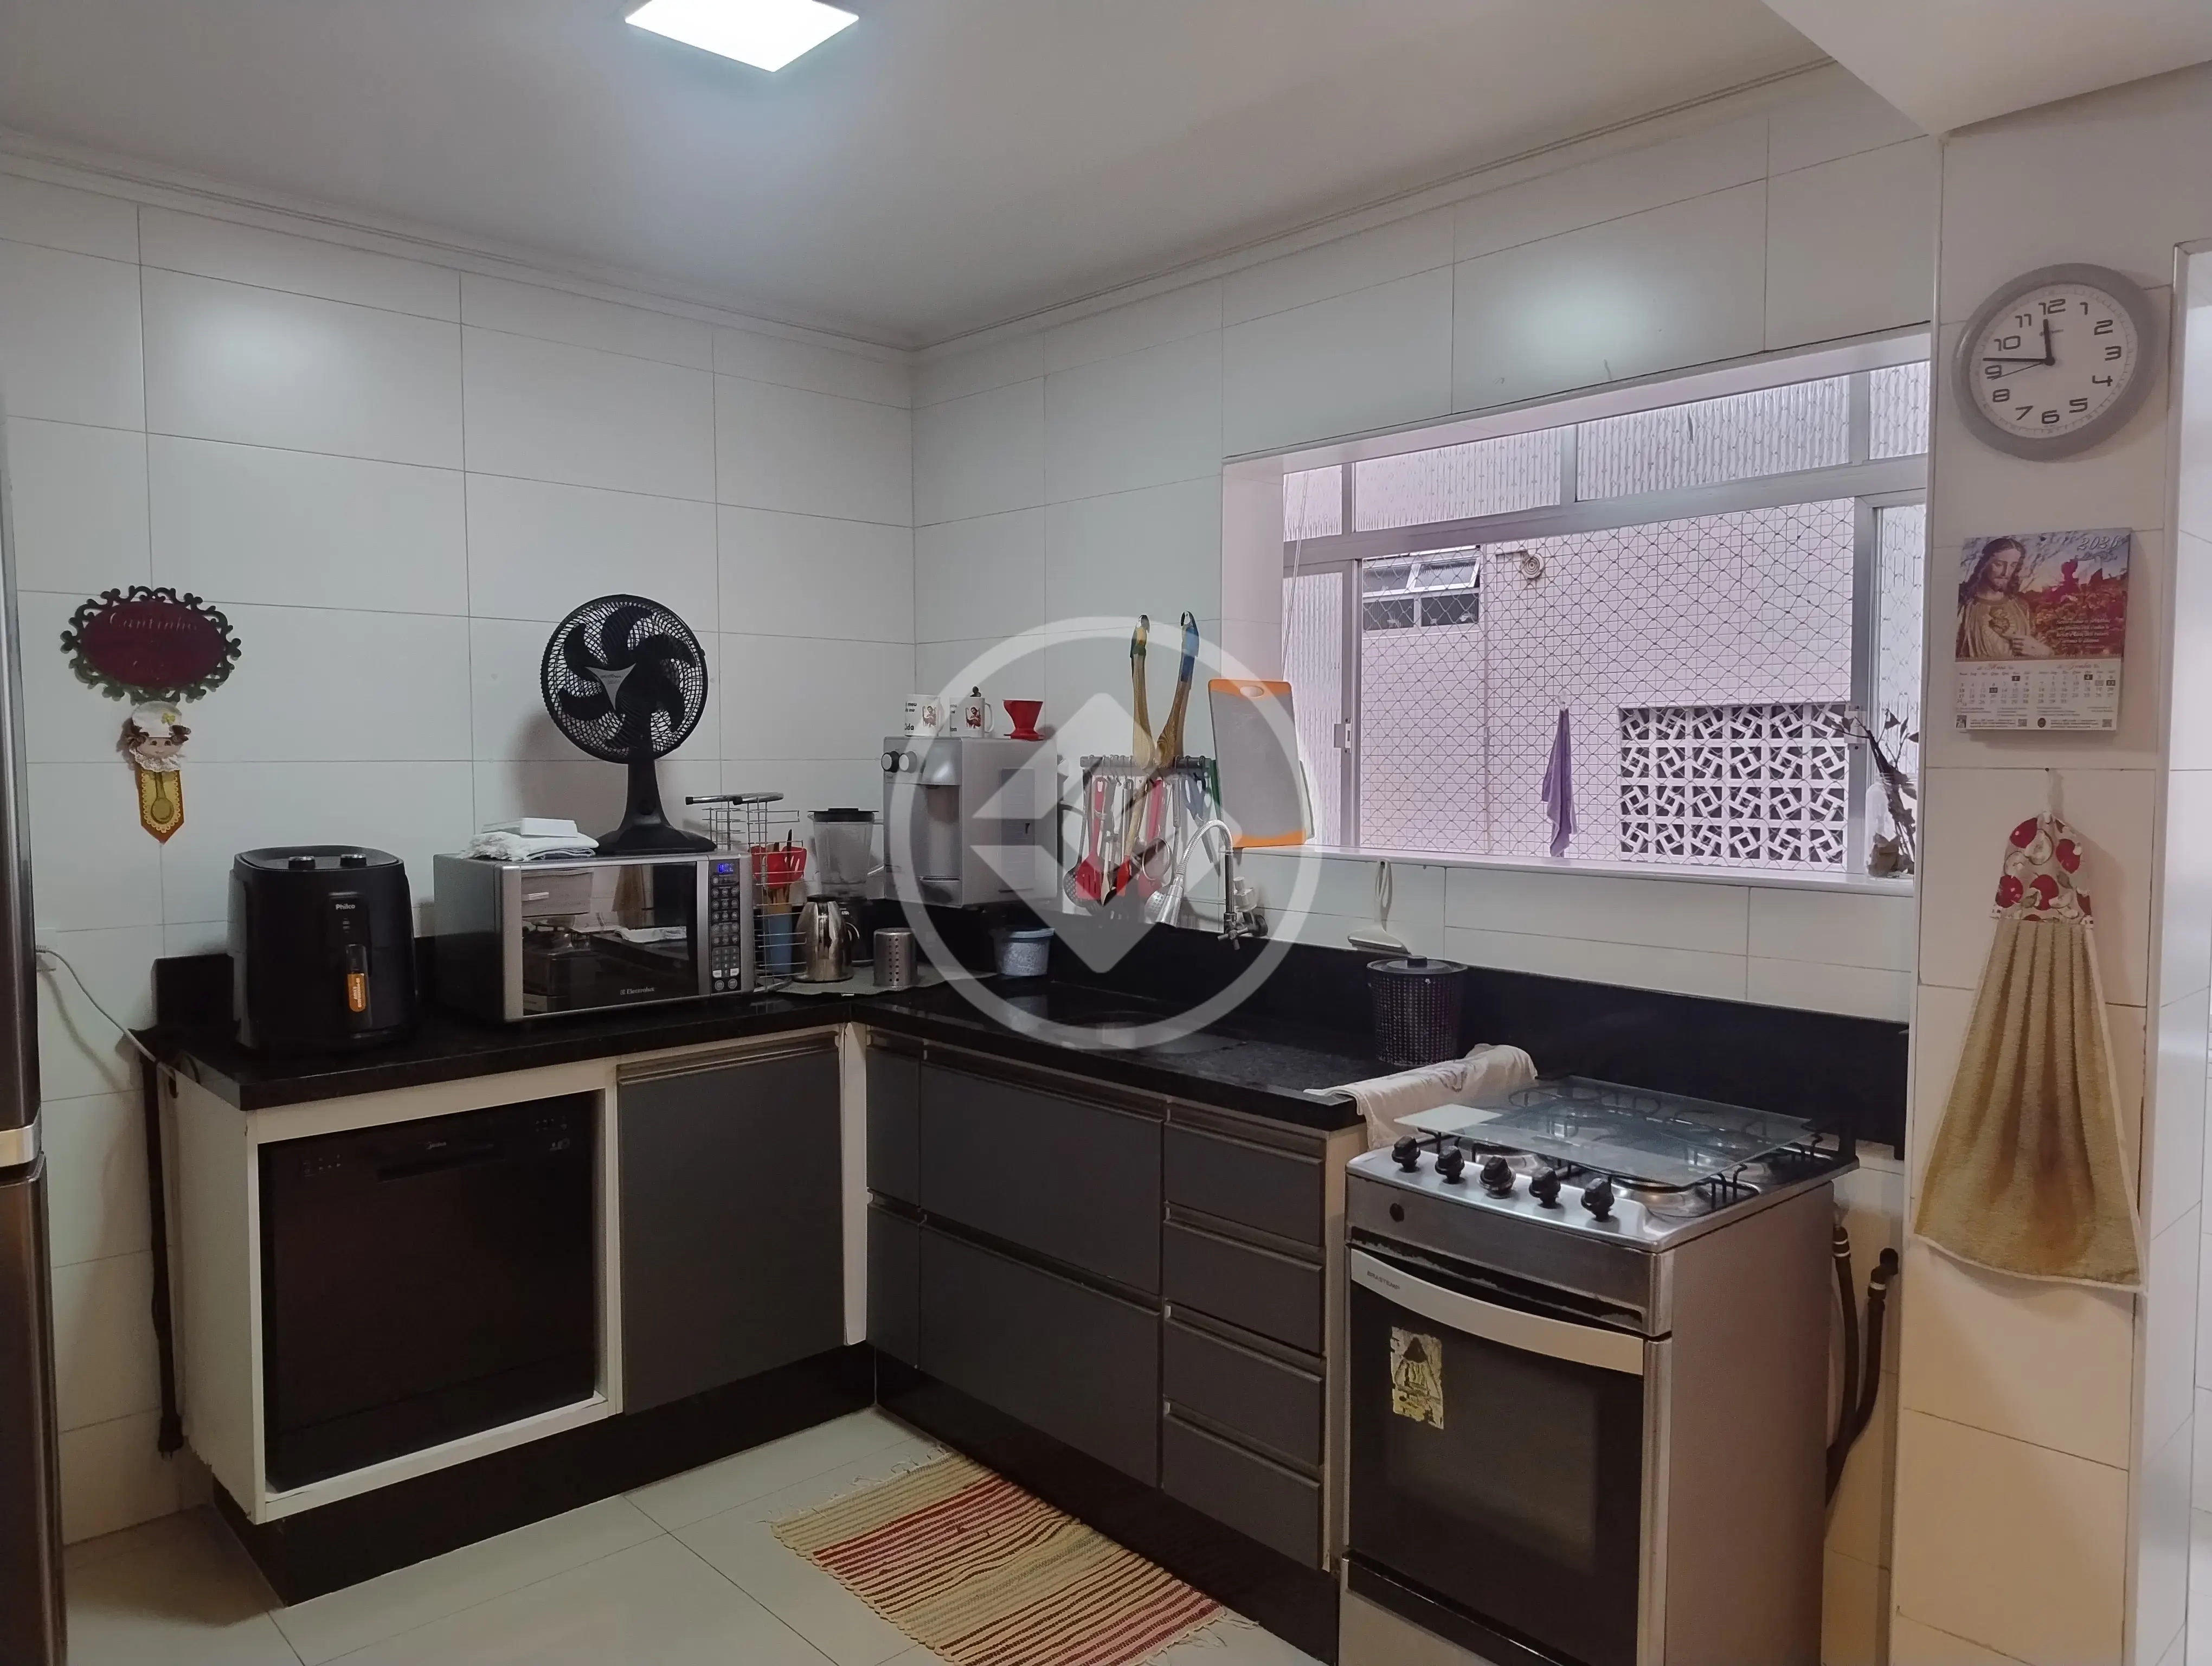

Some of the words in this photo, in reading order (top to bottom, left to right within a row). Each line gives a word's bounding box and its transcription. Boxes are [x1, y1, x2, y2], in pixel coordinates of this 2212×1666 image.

[2038, 298, 2066, 315] 12
[2079, 302, 2088, 315] 1
[2015, 313, 2032, 328] 11
[2094, 319, 2113, 336] 2
[1994, 335, 2021, 351] 10
[2104, 345, 2122, 362] 3
[1984, 364, 2002, 380] 9
[2092, 375, 2113, 387] 4
[1992, 388, 2010, 403] 8
[2015, 405, 2034, 421] 7
[2069, 397, 2088, 414] 5
[2041, 409, 2060, 425] 6
